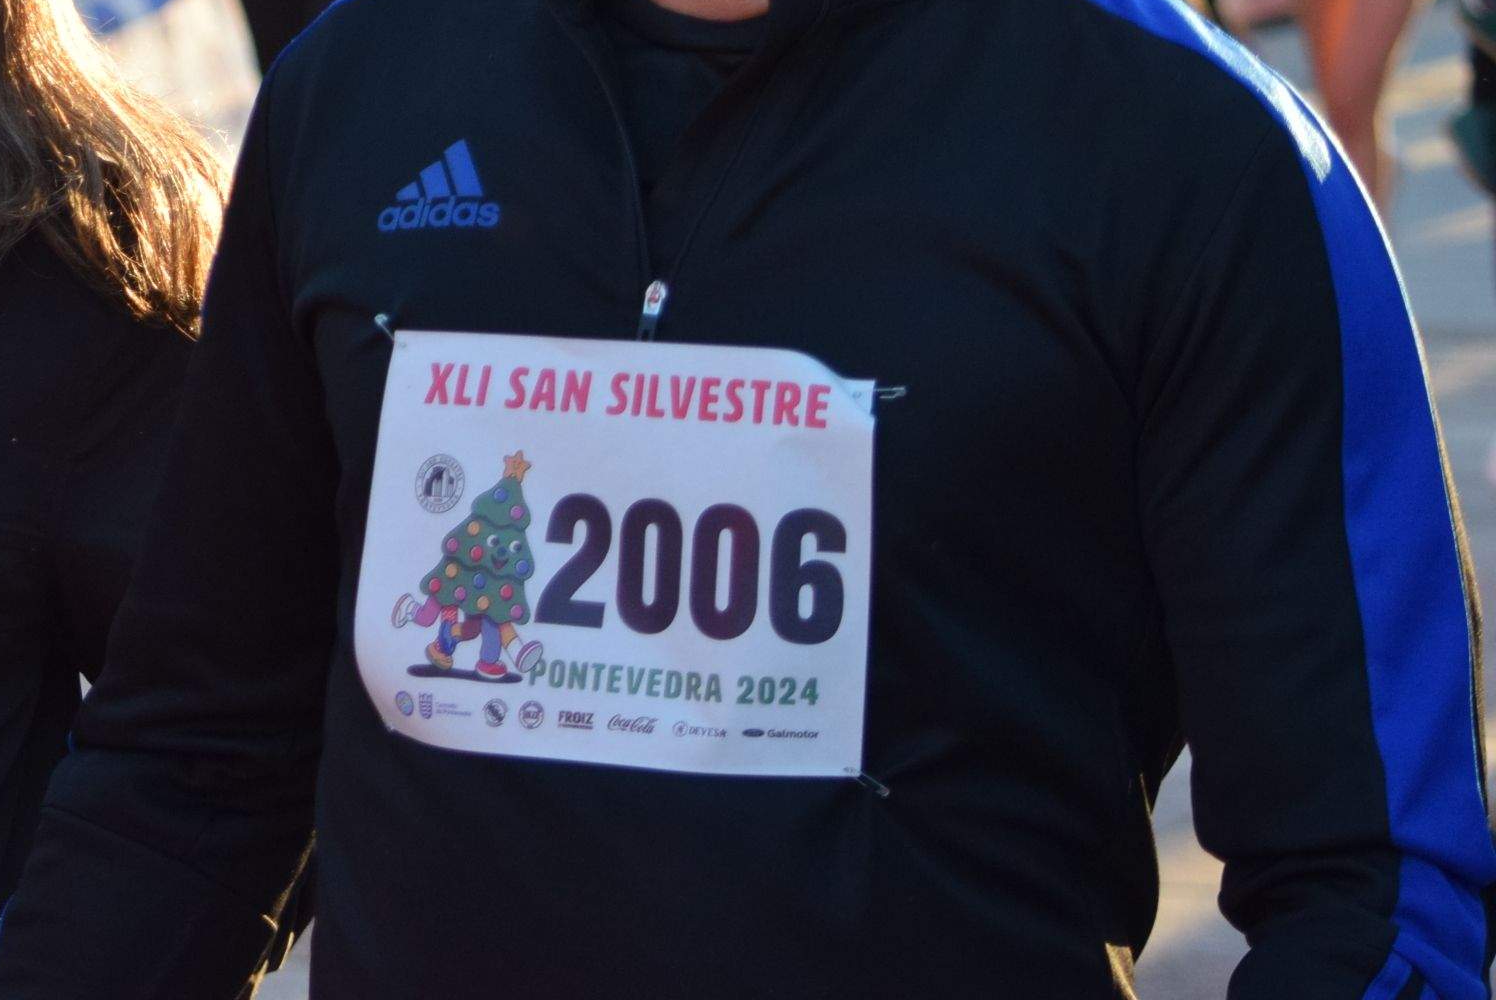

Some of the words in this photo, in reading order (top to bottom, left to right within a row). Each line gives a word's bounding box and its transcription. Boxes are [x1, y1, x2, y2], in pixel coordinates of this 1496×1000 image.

[377, 197, 501, 232] adidas
[424, 363, 492, 407] XLI
[505, 367, 592, 413] SAN
[606, 372, 831, 429] SILVESTRE
[535, 493, 847, 645] 2006
[528, 659, 723, 703] PONTEVEDRA
[736, 675, 820, 706] 2024
[557, 709, 595, 725] FROIZ
